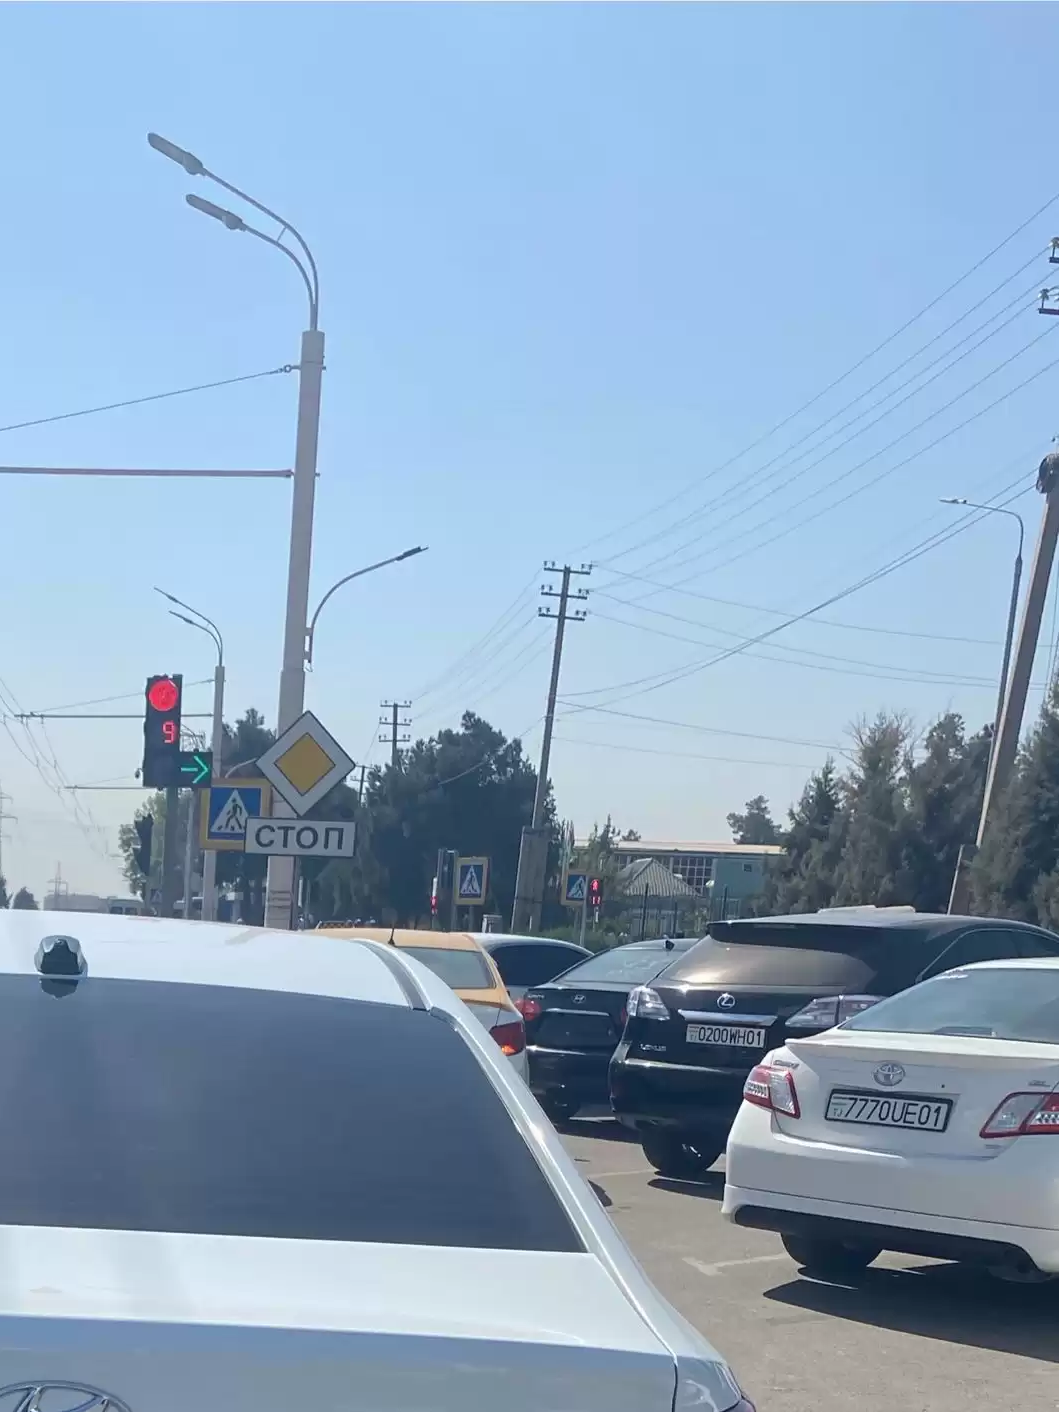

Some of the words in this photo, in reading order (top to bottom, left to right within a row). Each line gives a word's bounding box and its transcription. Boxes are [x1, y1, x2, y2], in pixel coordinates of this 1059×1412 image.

[162, 720, 175, 744] 9
[254, 824, 344, 850] СТОП
[698, 1026, 762, 1046] 0200WH01
[844, 1097, 942, 1128] 7770UE01
